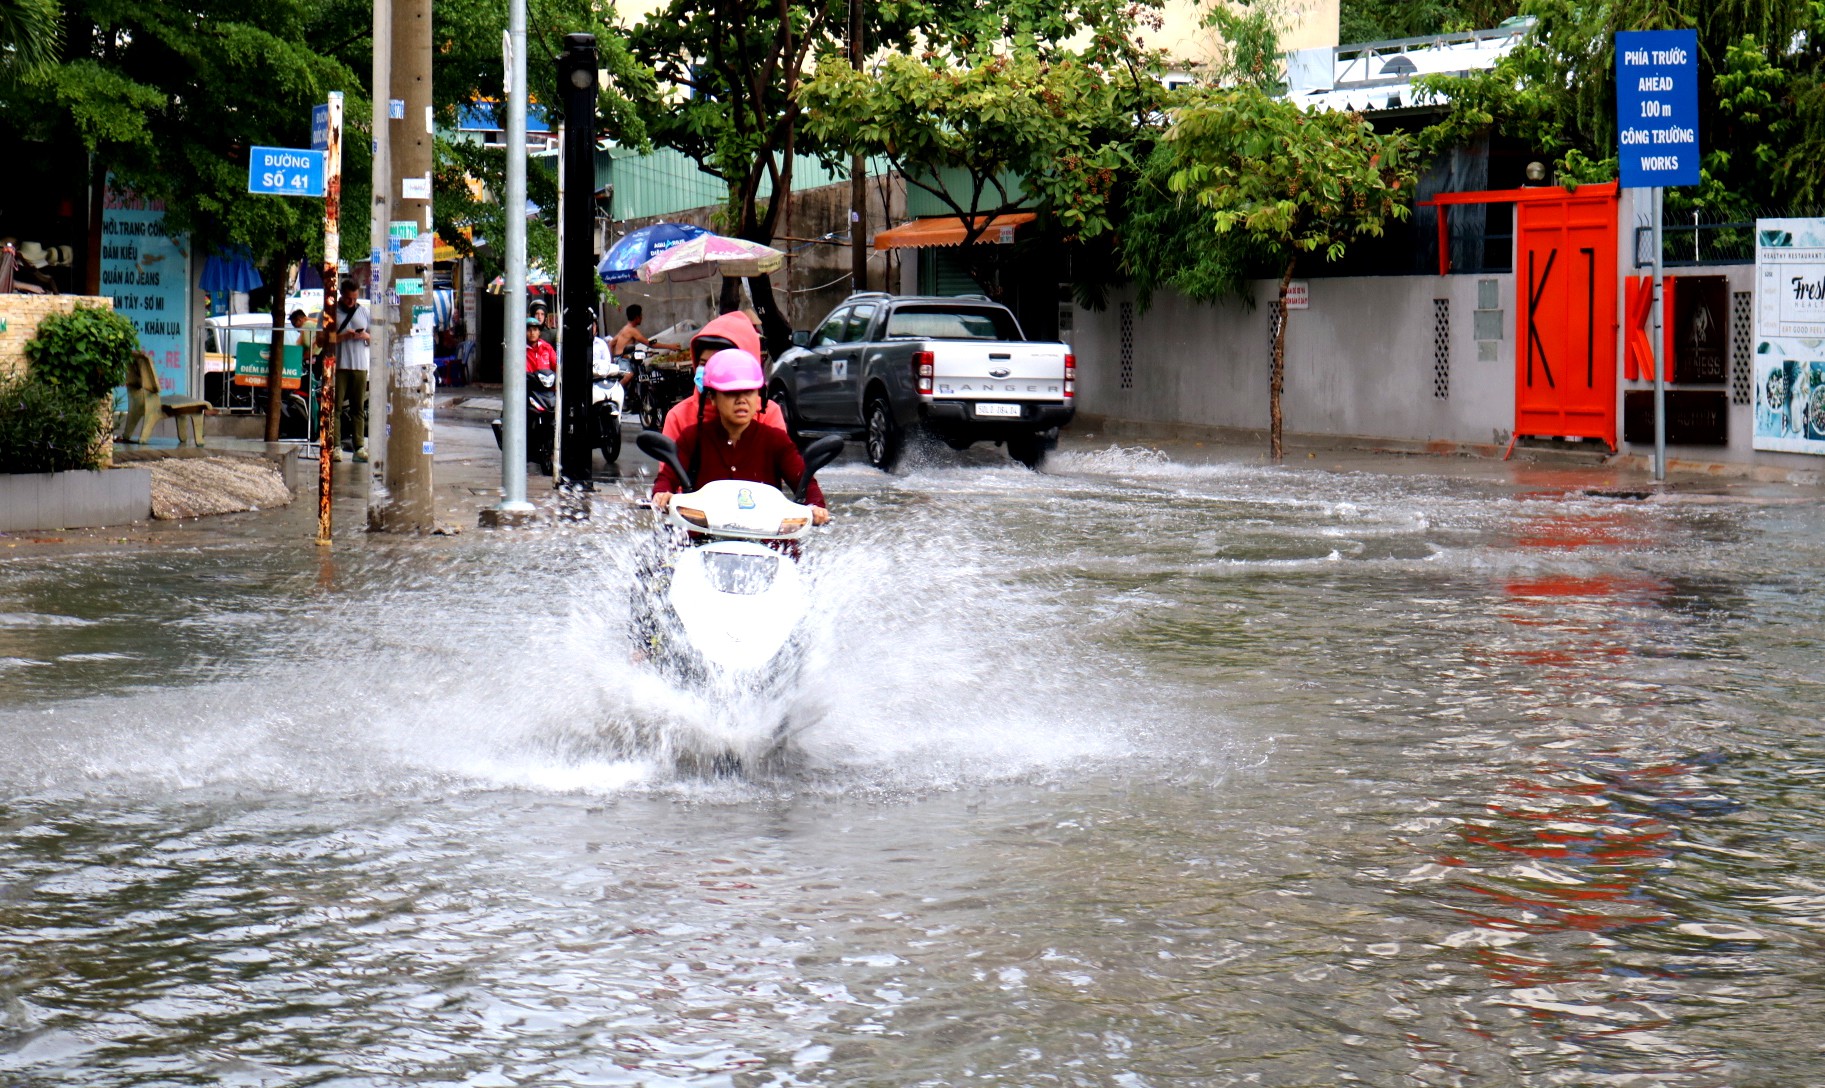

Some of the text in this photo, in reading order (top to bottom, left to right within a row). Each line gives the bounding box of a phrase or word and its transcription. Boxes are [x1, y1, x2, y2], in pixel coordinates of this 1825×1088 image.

[1624, 46, 1687, 65] PHÍA TRƯỚC
[1638, 76, 1673, 92] AHEAD
[1640, 100, 1672, 117] 100 m
[1621, 124, 1694, 145] CÔNG TRƯỜNG
[264, 153, 310, 169] ĐƯỜNG
[1640, 156, 1679, 171] WORKS
[262, 169, 308, 189] SỐ 41
[119, 221, 145, 236] TRANG
[1763, 252, 1786, 260] HEALTHY
[1788, 252, 1822, 260] RESTAURANT
[124, 267, 135, 285] ÁO
[136, 271, 160, 287] JEANS
[124, 293, 139, 310] TÂY
[155, 297, 164, 311] MI
[166, 321, 181, 340] LỤA
[1793, 326, 1809, 334] GOOD
[1810, 326, 1823, 334] FEEL
[240, 363, 259, 373] ĐIỂM
[938, 383, 1059, 393] RANGER
